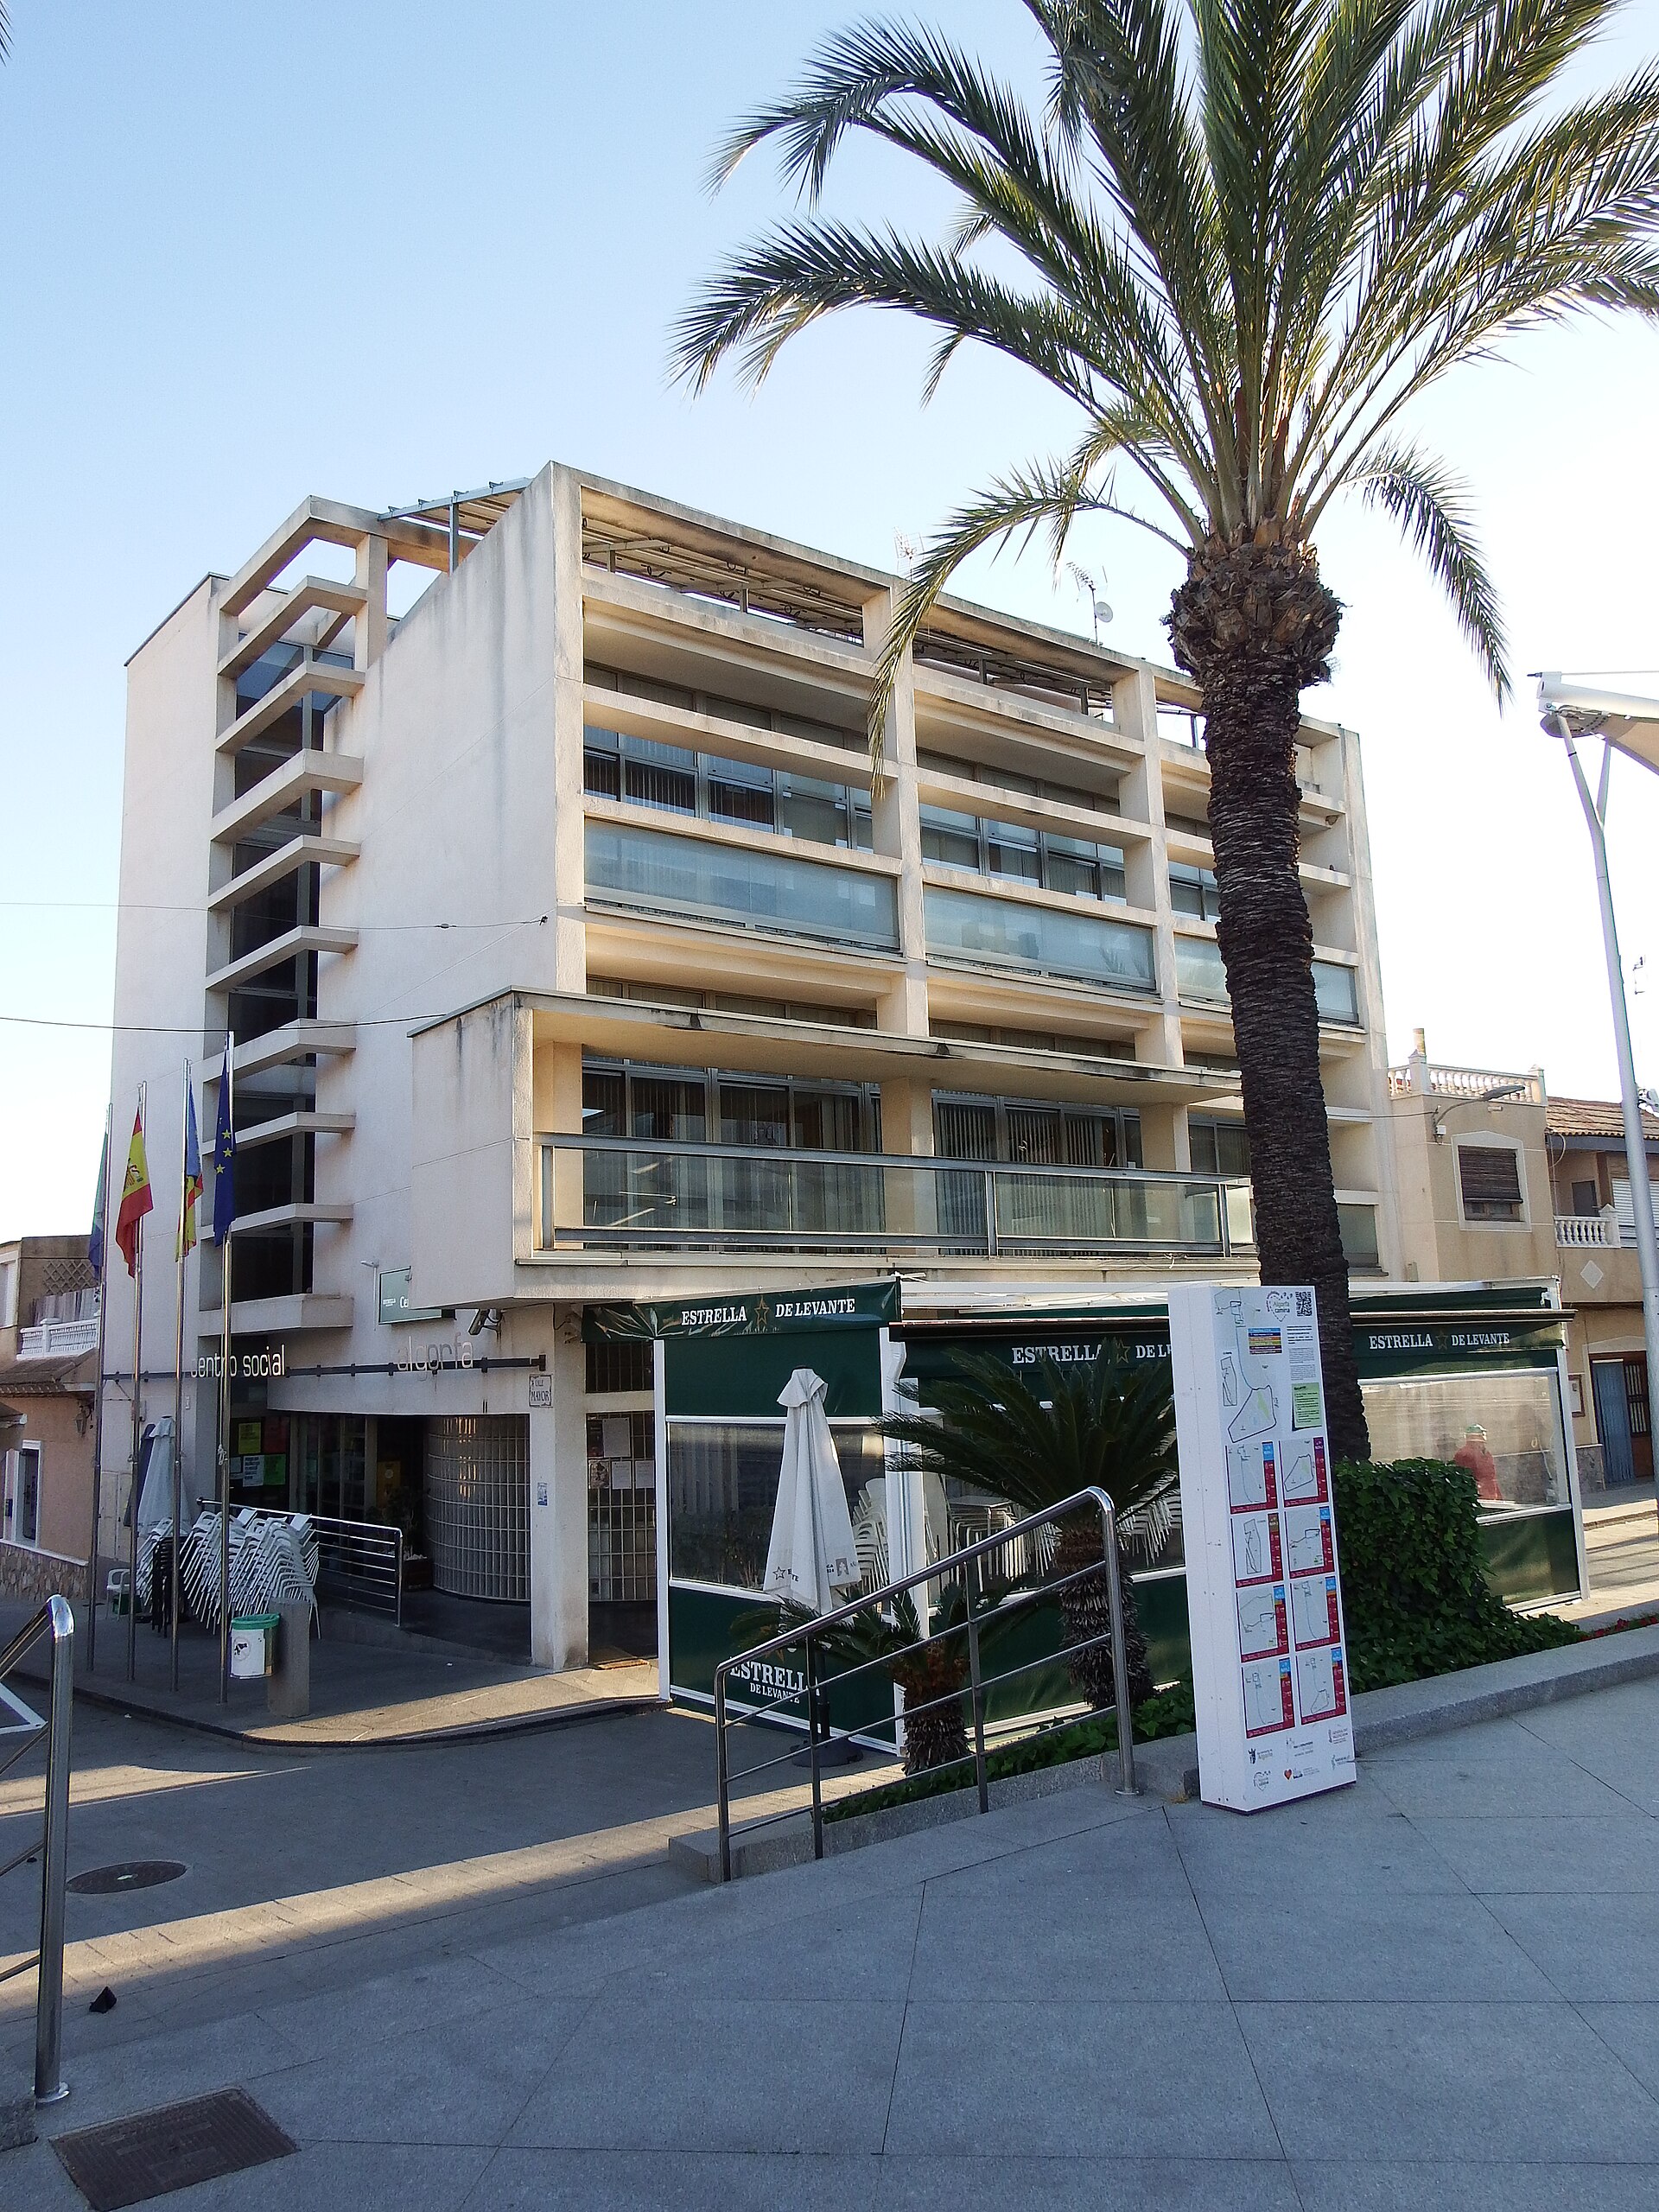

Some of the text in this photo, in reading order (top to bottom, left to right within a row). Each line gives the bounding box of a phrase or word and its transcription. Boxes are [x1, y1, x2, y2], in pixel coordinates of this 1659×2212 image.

[681, 1298, 855, 1325] ESTRELLA DE LEVANTE
[1135, 1344, 1156, 1359] DE
[1369, 1332, 1510, 1350] ESTRELLA DE LEVANTE
[243, 1344, 285, 1377] social
[397, 1332, 474, 1382] algorfa
[750, 1682, 761, 1694] DE
